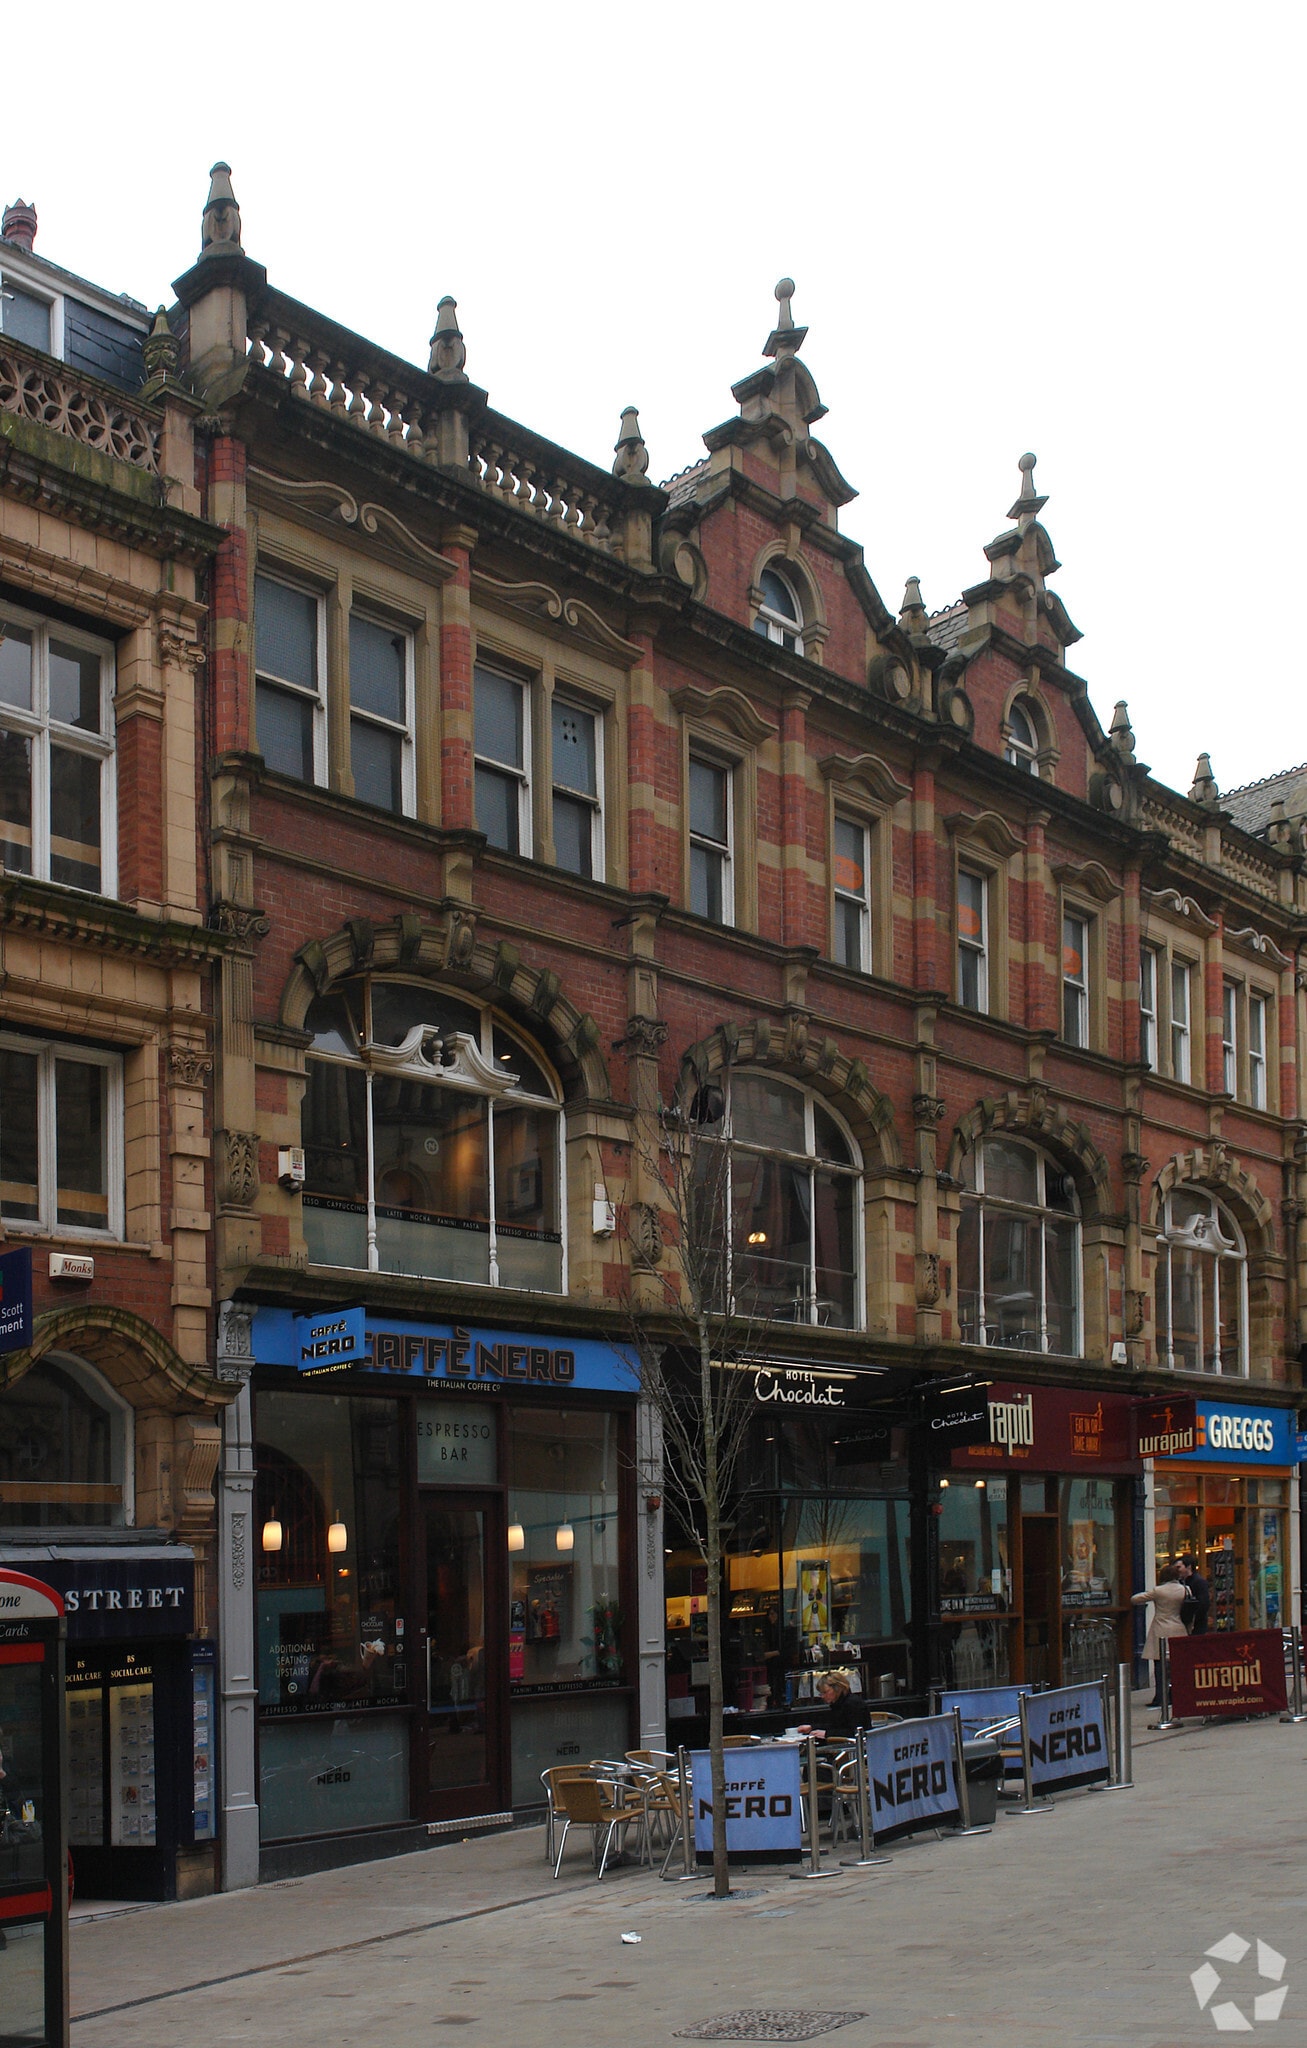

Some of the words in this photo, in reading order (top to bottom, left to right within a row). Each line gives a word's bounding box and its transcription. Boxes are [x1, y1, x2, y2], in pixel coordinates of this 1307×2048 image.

[303, 1196, 319, 1205] ESSO
[63, 1257, 92, 1275] Monks
[1, 1302, 24, 1319] Scott
[310, 1319, 347, 1338] CAFFÈ
[301, 1335, 355, 1360] NERO
[311, 1367, 329, 1376] ITALIAN
[329, 1363, 347, 1372] COFFEE
[476, 1341, 575, 1382] NERO
[785, 1369, 815, 1383] HOTEL
[427, 1379, 439, 1388] THE
[440, 1380, 466, 1389] ITALIAN
[467, 1382, 492, 1391] COFFEE
[947, 1411, 967, 1419] HOTEL
[417, 1421, 491, 1440] ESPRESSO
[987, 1393, 1034, 1456] rapid
[1208, 1414, 1274, 1452] GREGGS
[1139, 1427, 1194, 1455] wrapid
[440, 1446, 468, 1462] BAR
[64, 1587, 185, 1611] STREET
[269, 1643, 316, 1654] ADDITIONAL
[276, 1655, 308, 1666] SEATING
[64, 1673, 84, 1683] OCIAL
[84, 1671, 102, 1681] CARE
[110, 1668, 134, 1678] SOCIAL
[134, 1666, 153, 1675] CARE
[275, 1666, 310, 1678] UPSTAIRS
[1194, 1659, 1262, 1692] wrapid
[1195, 1696, 1264, 1707] www.wrapid.com
[1048, 1703, 1081, 1725] CAFFÈ
[556, 1745, 580, 1757] NERO
[894, 1738, 929, 1762] CAFFÈ
[1030, 1723, 1102, 1767] NERO
[317, 1772, 351, 1786] NERO
[873, 1760, 946, 1812] NERO
[699, 1794, 792, 1820] NERO
